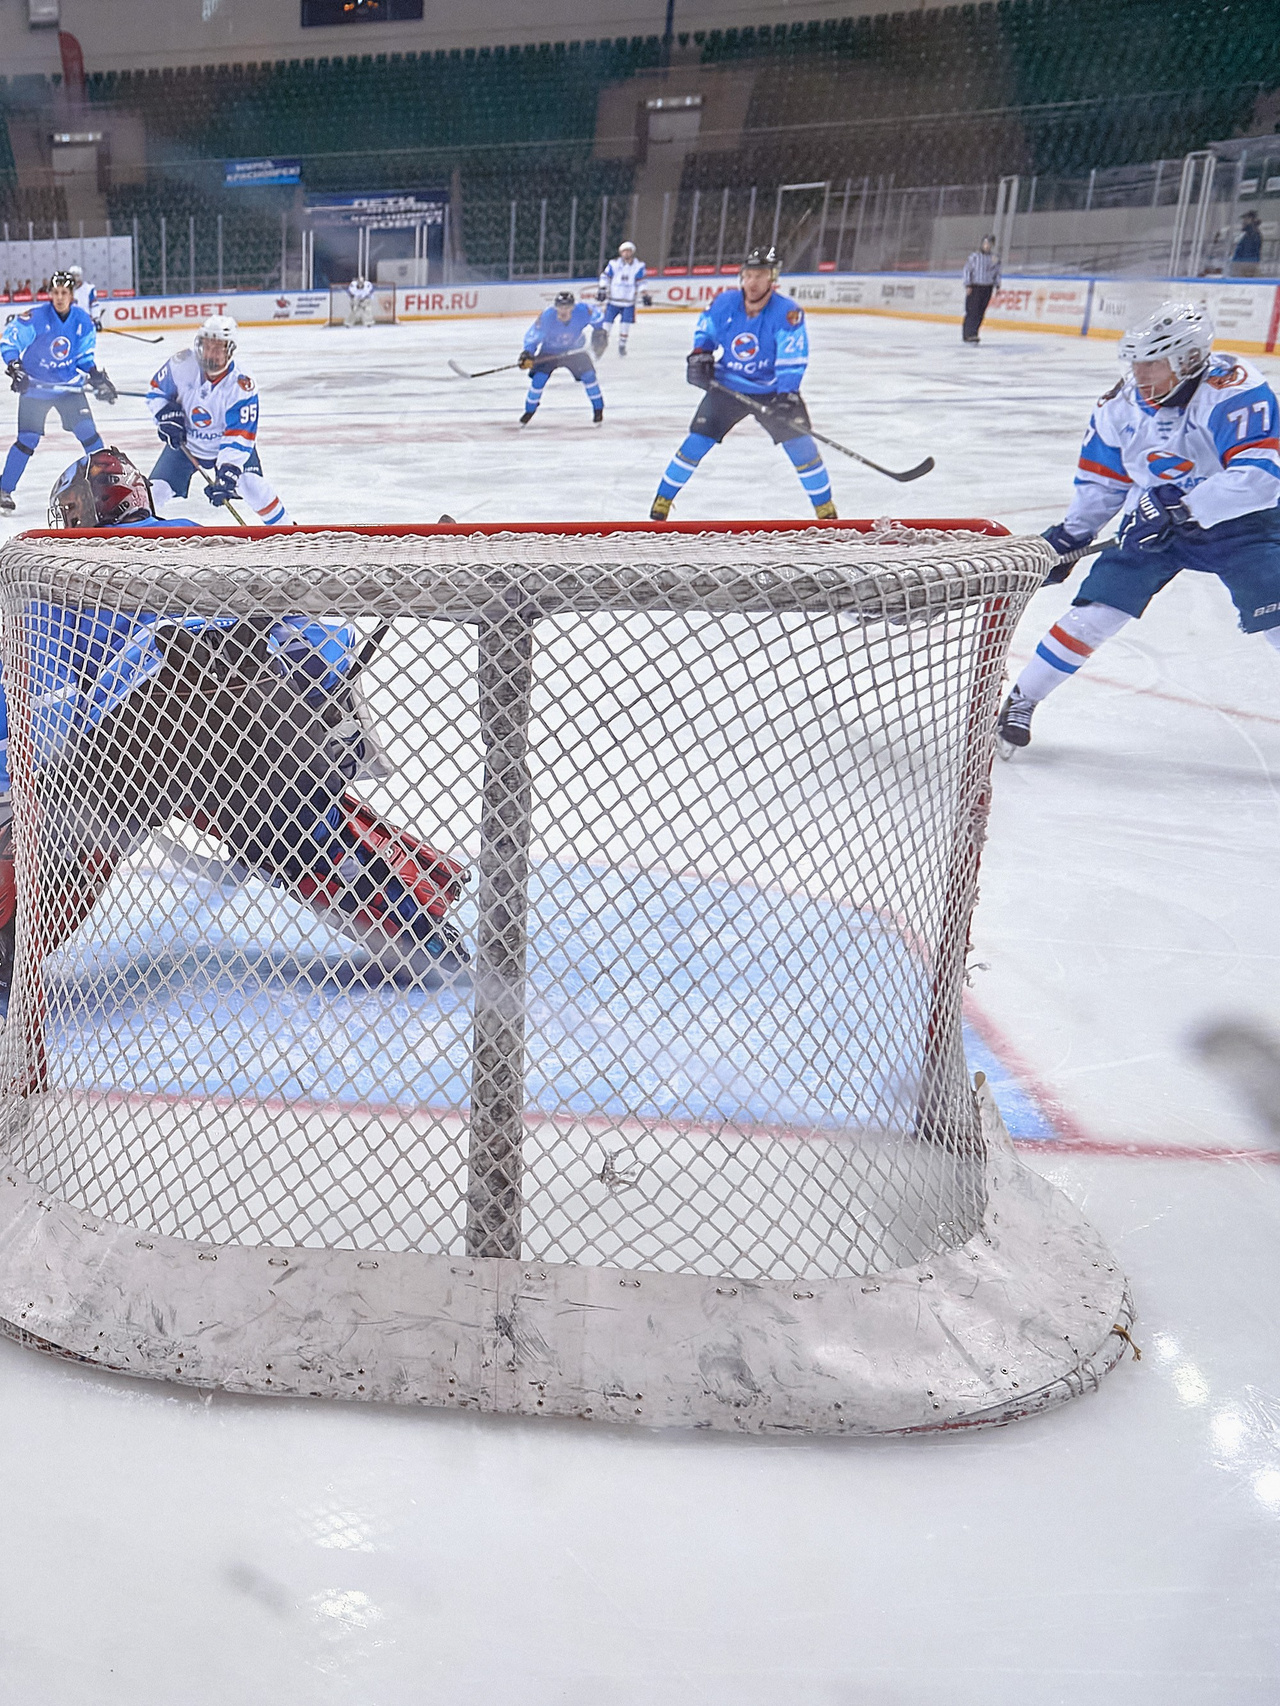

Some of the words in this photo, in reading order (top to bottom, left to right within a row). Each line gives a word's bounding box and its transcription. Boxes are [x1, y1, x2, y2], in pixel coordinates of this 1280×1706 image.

[405, 290, 479, 311] FHR.RU
[114, 303, 227, 321] OLIMPBET
[784, 335, 805, 354] 24
[240, 403, 258, 424] 95
[1227, 400, 1271, 440] 77
